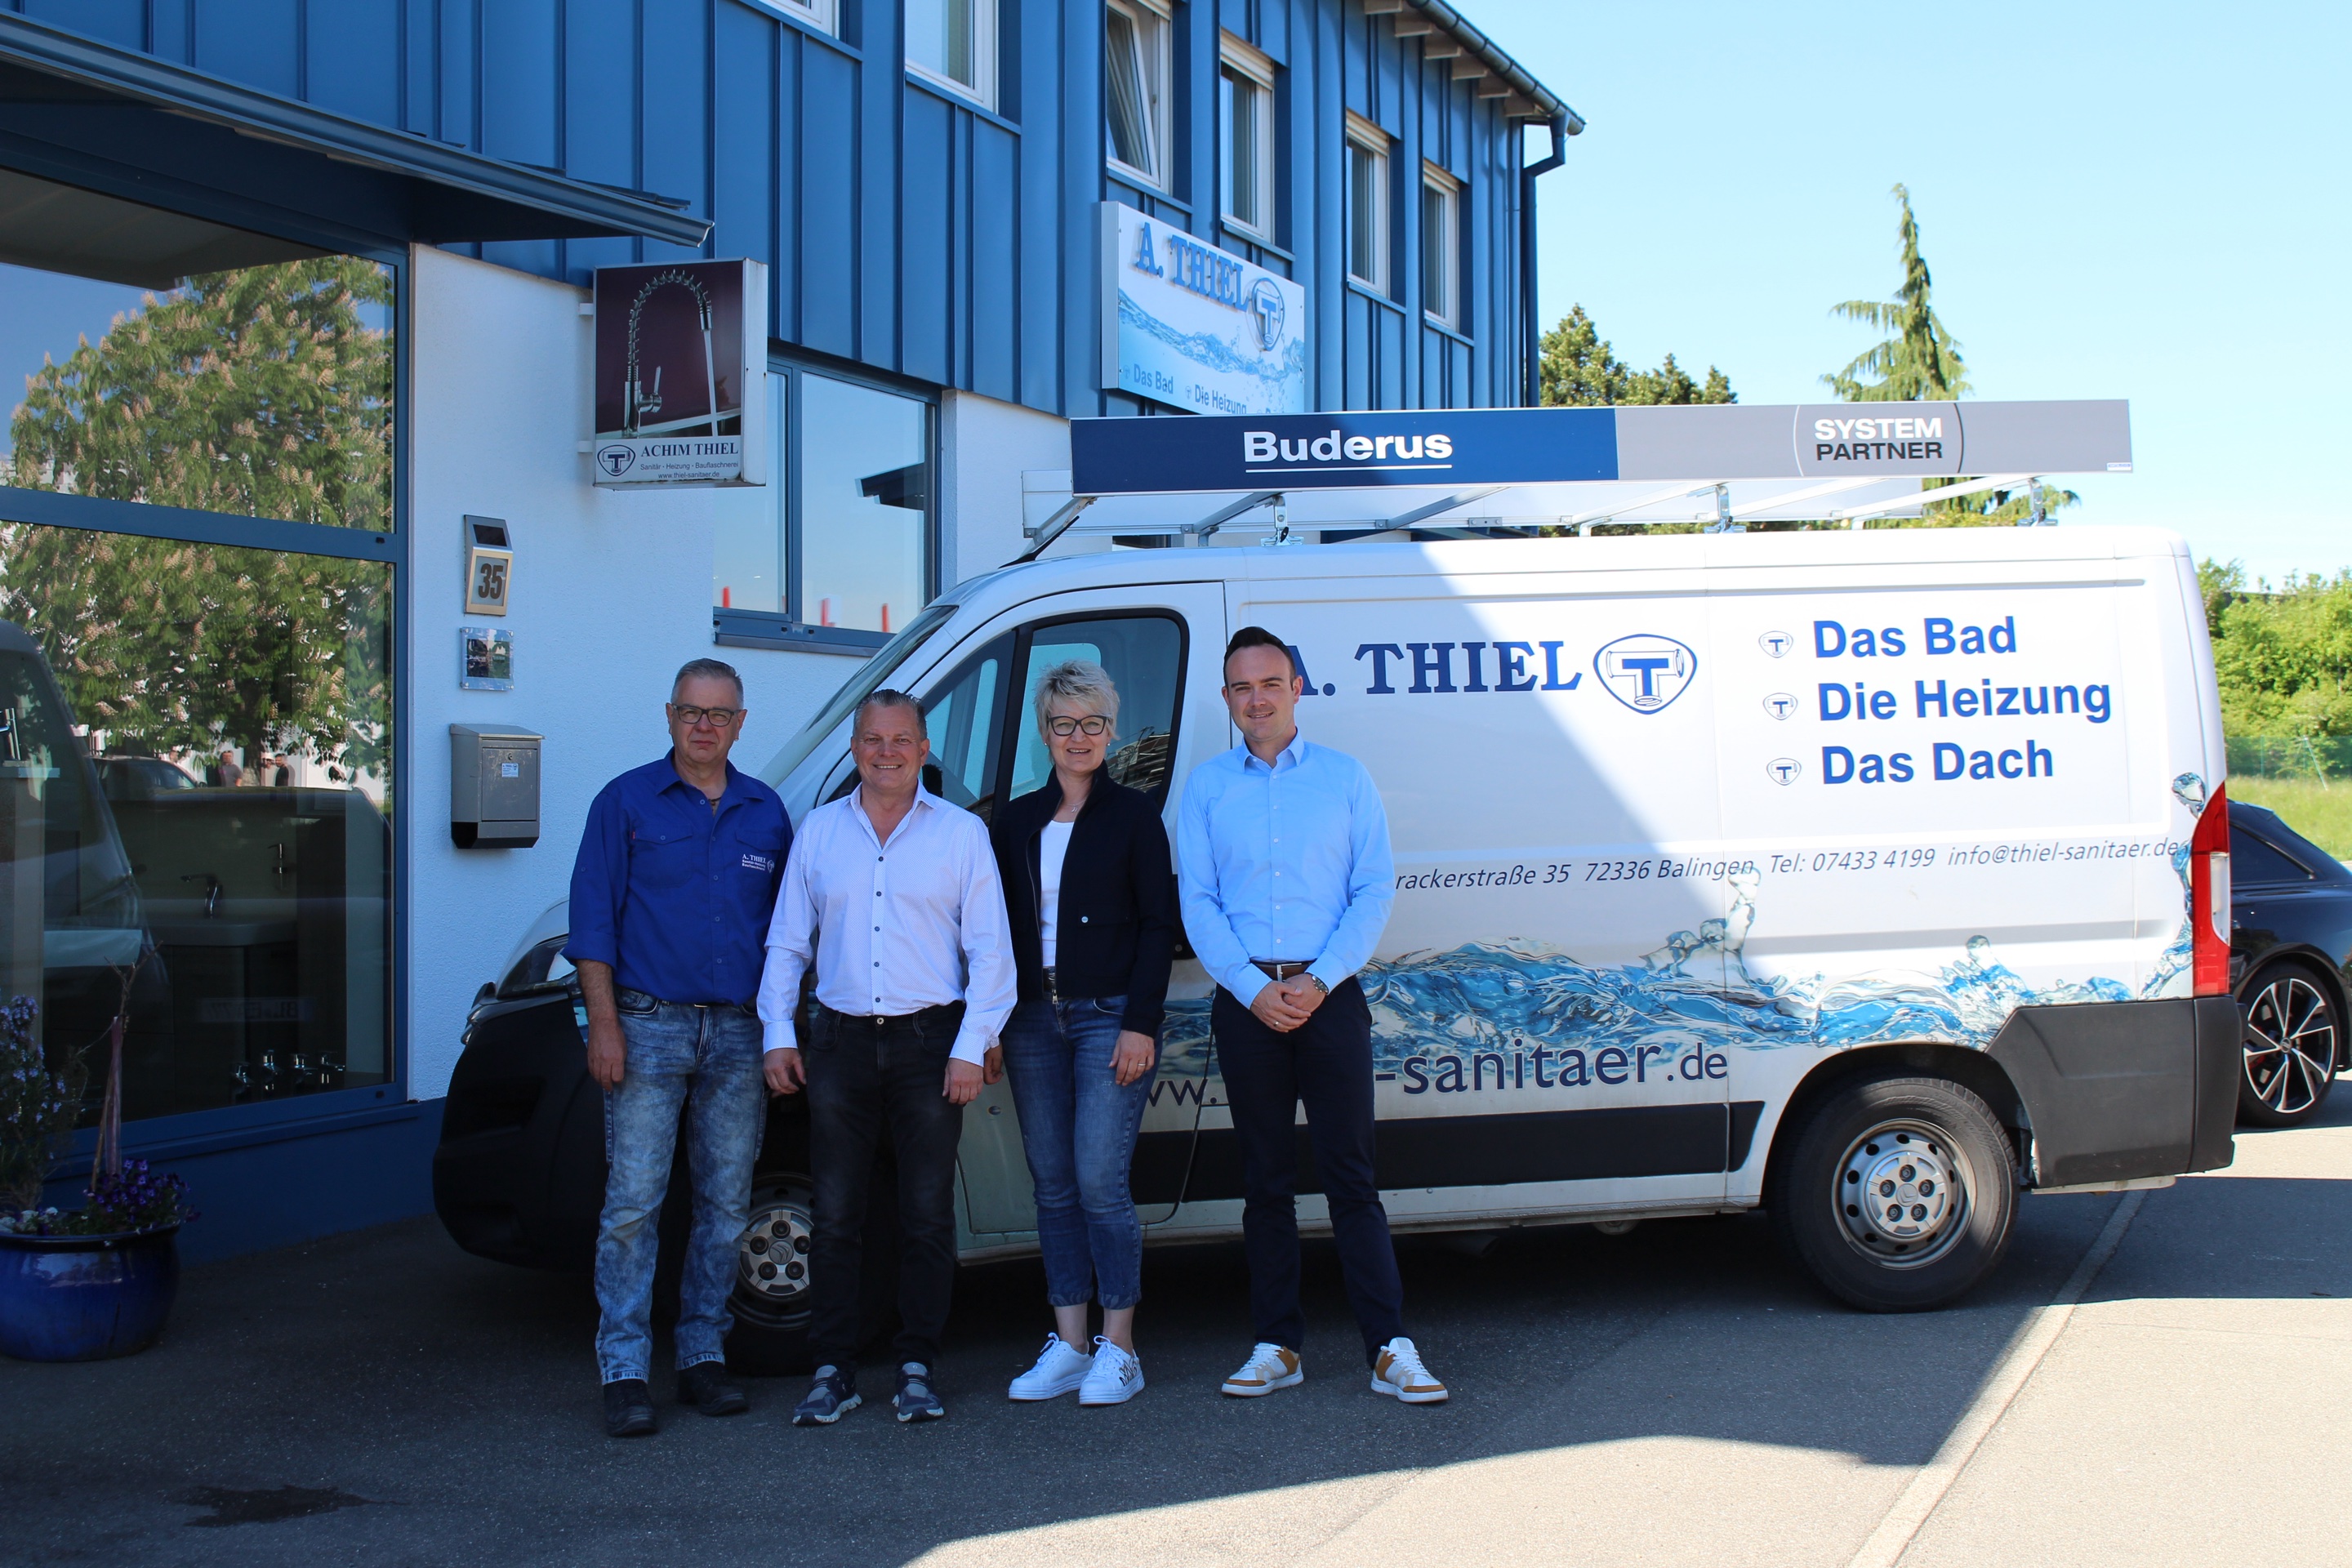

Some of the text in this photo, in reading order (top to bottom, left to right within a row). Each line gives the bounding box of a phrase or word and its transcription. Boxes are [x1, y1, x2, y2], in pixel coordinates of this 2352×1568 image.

[1137, 222, 1250, 313] A. THIEL
[1134, 364, 1152, 387] Das
[1156, 371, 1174, 394] Bad
[1195, 385, 1209, 406] Die
[1244, 429, 1453, 463] Buderus
[1814, 417, 1943, 441] SYSTEM
[640, 442, 738, 457] ACHIM THIEL
[666, 462, 690, 470] Heizung
[1815, 442, 1943, 461] PARTNER
[478, 564, 504, 599] 35
[1813, 620, 1907, 658] Das
[1924, 616, 2017, 655] Bad
[1354, 640, 1583, 695] THIEL
[1818, 682, 1897, 721] Die
[1915, 679, 2111, 724] Heizung
[1822, 745, 1914, 785] Das
[1932, 739, 2054, 782] Dach
[750, 854, 767, 864] THIEL
[1395, 837, 2180, 890] rackerstraße 35 72336 Balingen Tel: 07433 4199 info@thiel-sanitaer.de
